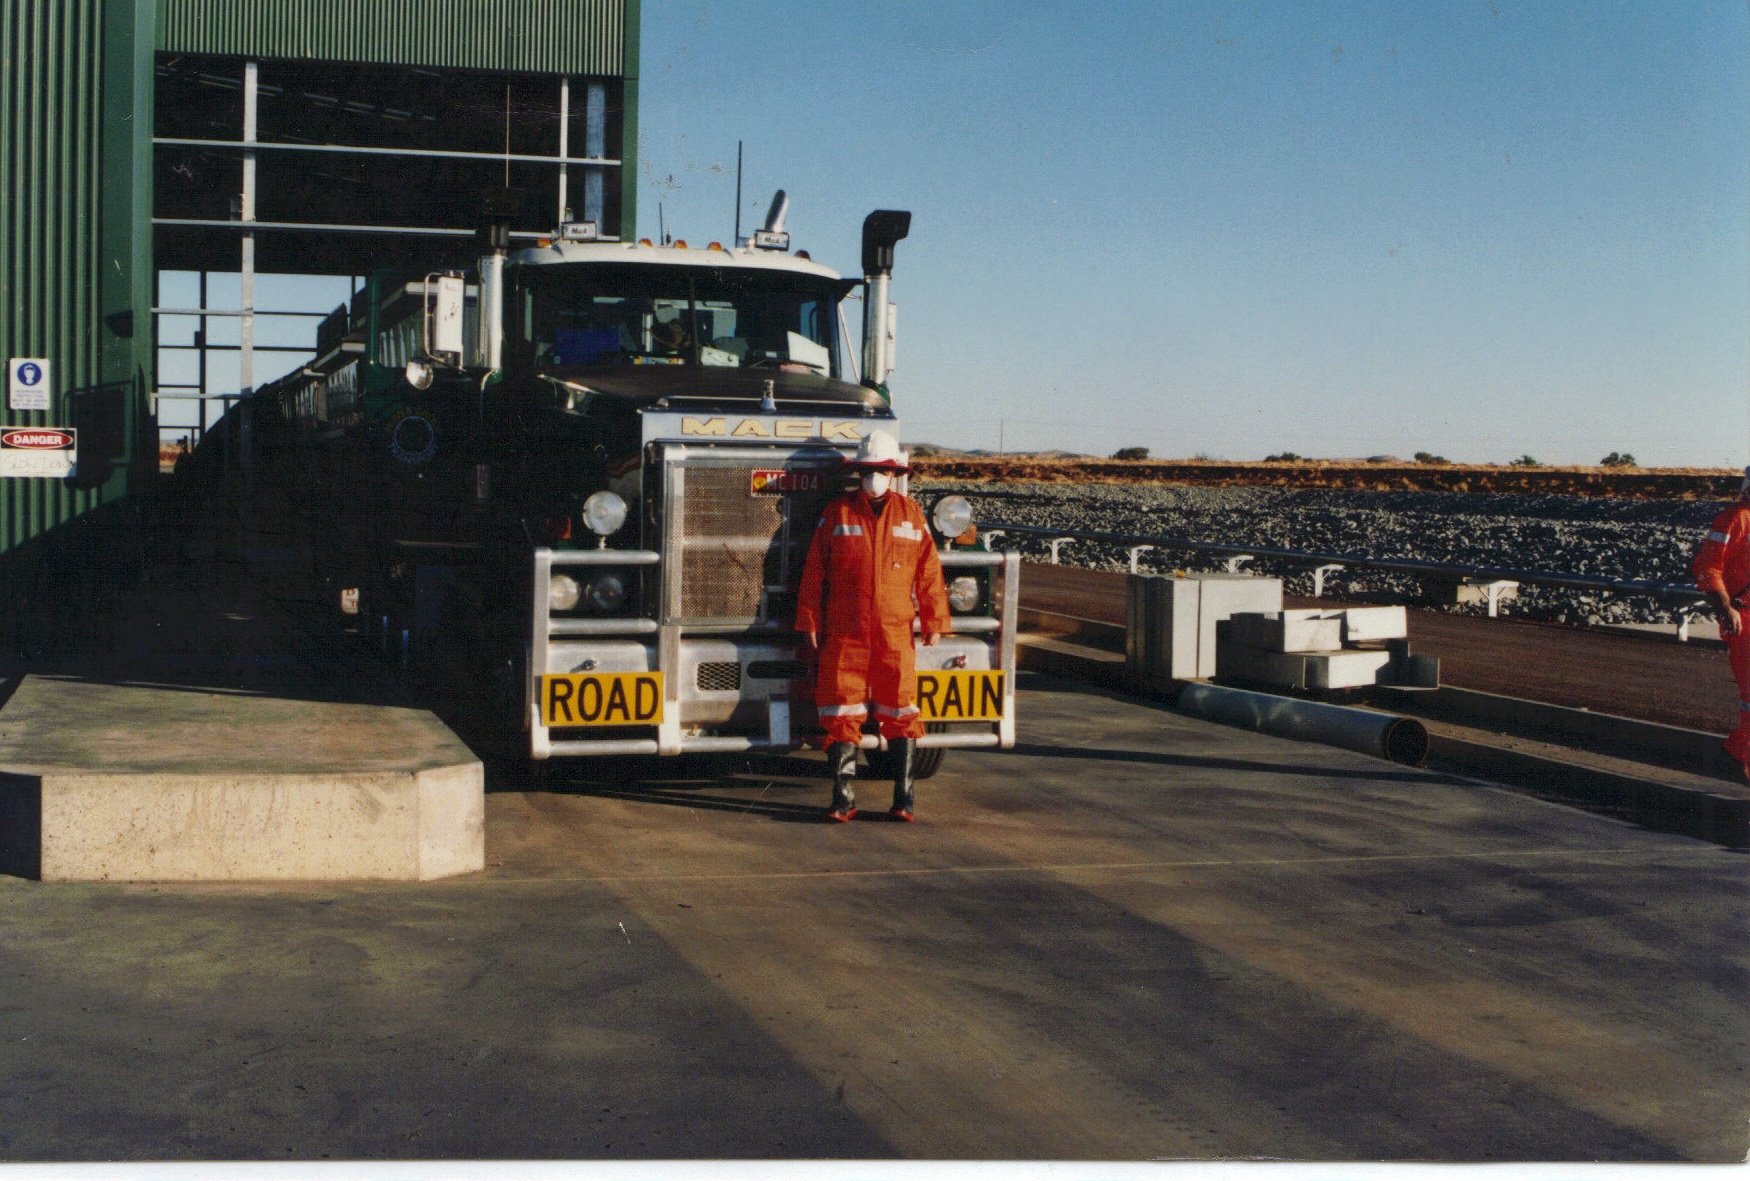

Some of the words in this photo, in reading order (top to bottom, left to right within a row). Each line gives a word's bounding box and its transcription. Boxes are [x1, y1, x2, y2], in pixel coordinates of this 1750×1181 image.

[681, 417, 864, 439] MACK
[13, 434, 63, 445] DANGER
[549, 677, 659, 722] ROAD
[917, 674, 1004, 718] RAIN
